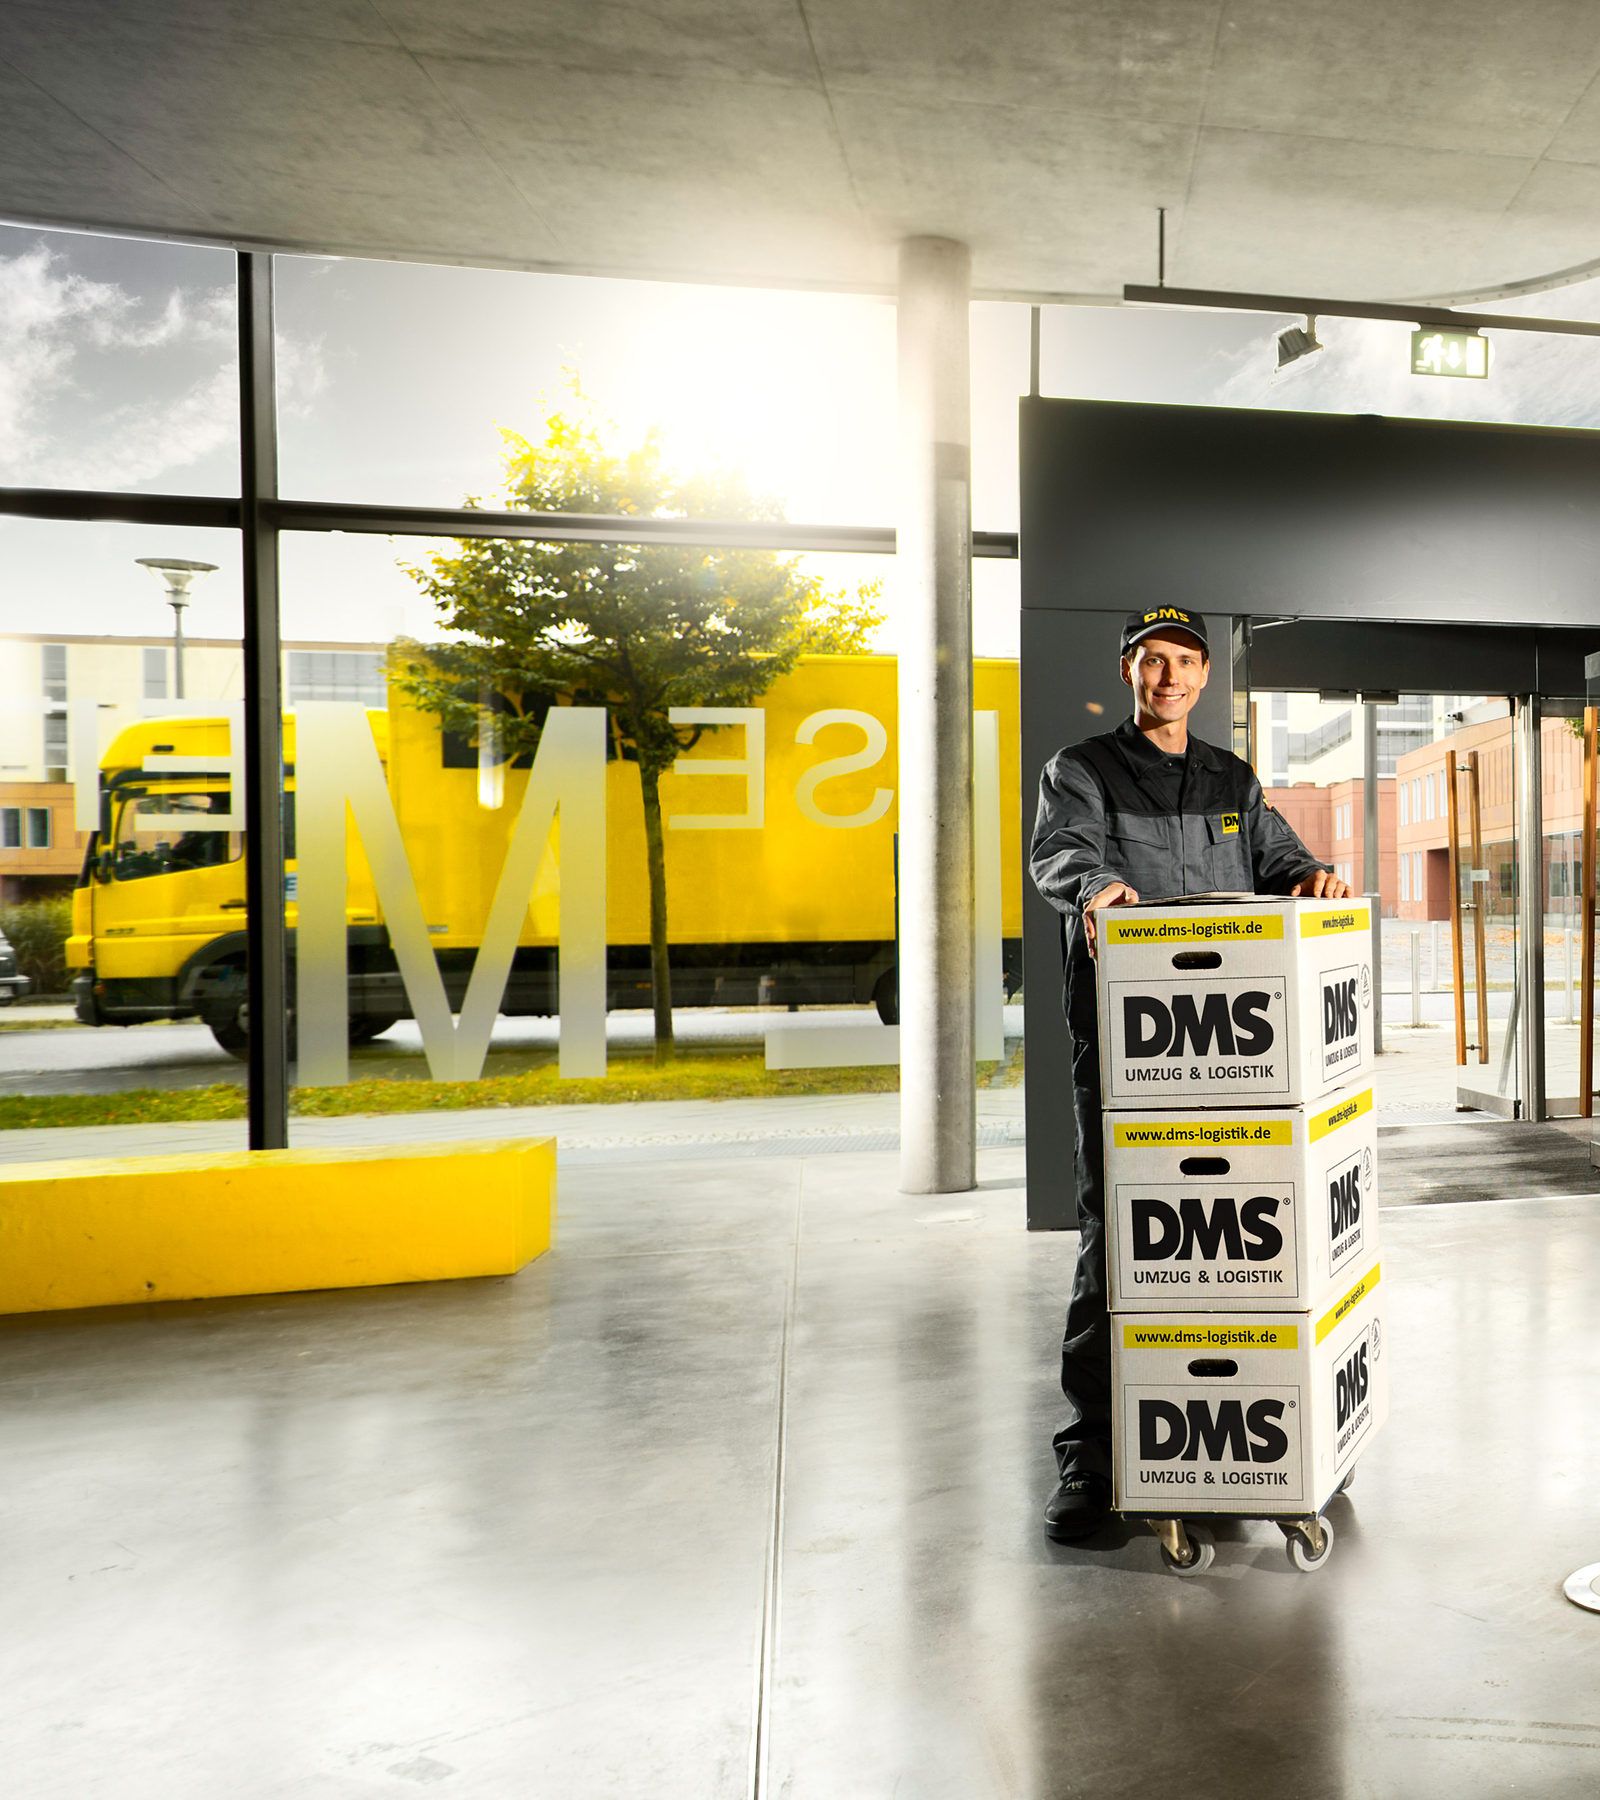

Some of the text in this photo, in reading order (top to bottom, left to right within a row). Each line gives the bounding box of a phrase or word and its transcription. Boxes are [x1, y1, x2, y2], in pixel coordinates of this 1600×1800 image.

[1143, 608, 1190, 624] DMS
[1118, 921, 1263, 938] www.dms-logistik.de
[1323, 978, 1357, 1046] DMS
[1123, 991, 1274, 1058] DMS
[1125, 1064, 1274, 1082] UMZUG & LOGISTIK
[1126, 1127, 1271, 1143] www.dms-logistik.de
[1330, 1165, 1360, 1241] DMS
[1131, 1196, 1283, 1261] DMS
[1134, 1270, 1283, 1283] UMZUG & LOGISTIK
[1135, 1330, 1277, 1345] www.dms-logistik.de
[1336, 1341, 1368, 1433] DMS
[1139, 1399, 1288, 1463] DMS
[1140, 1471, 1288, 1485] UMZUG & LOGISTIK
